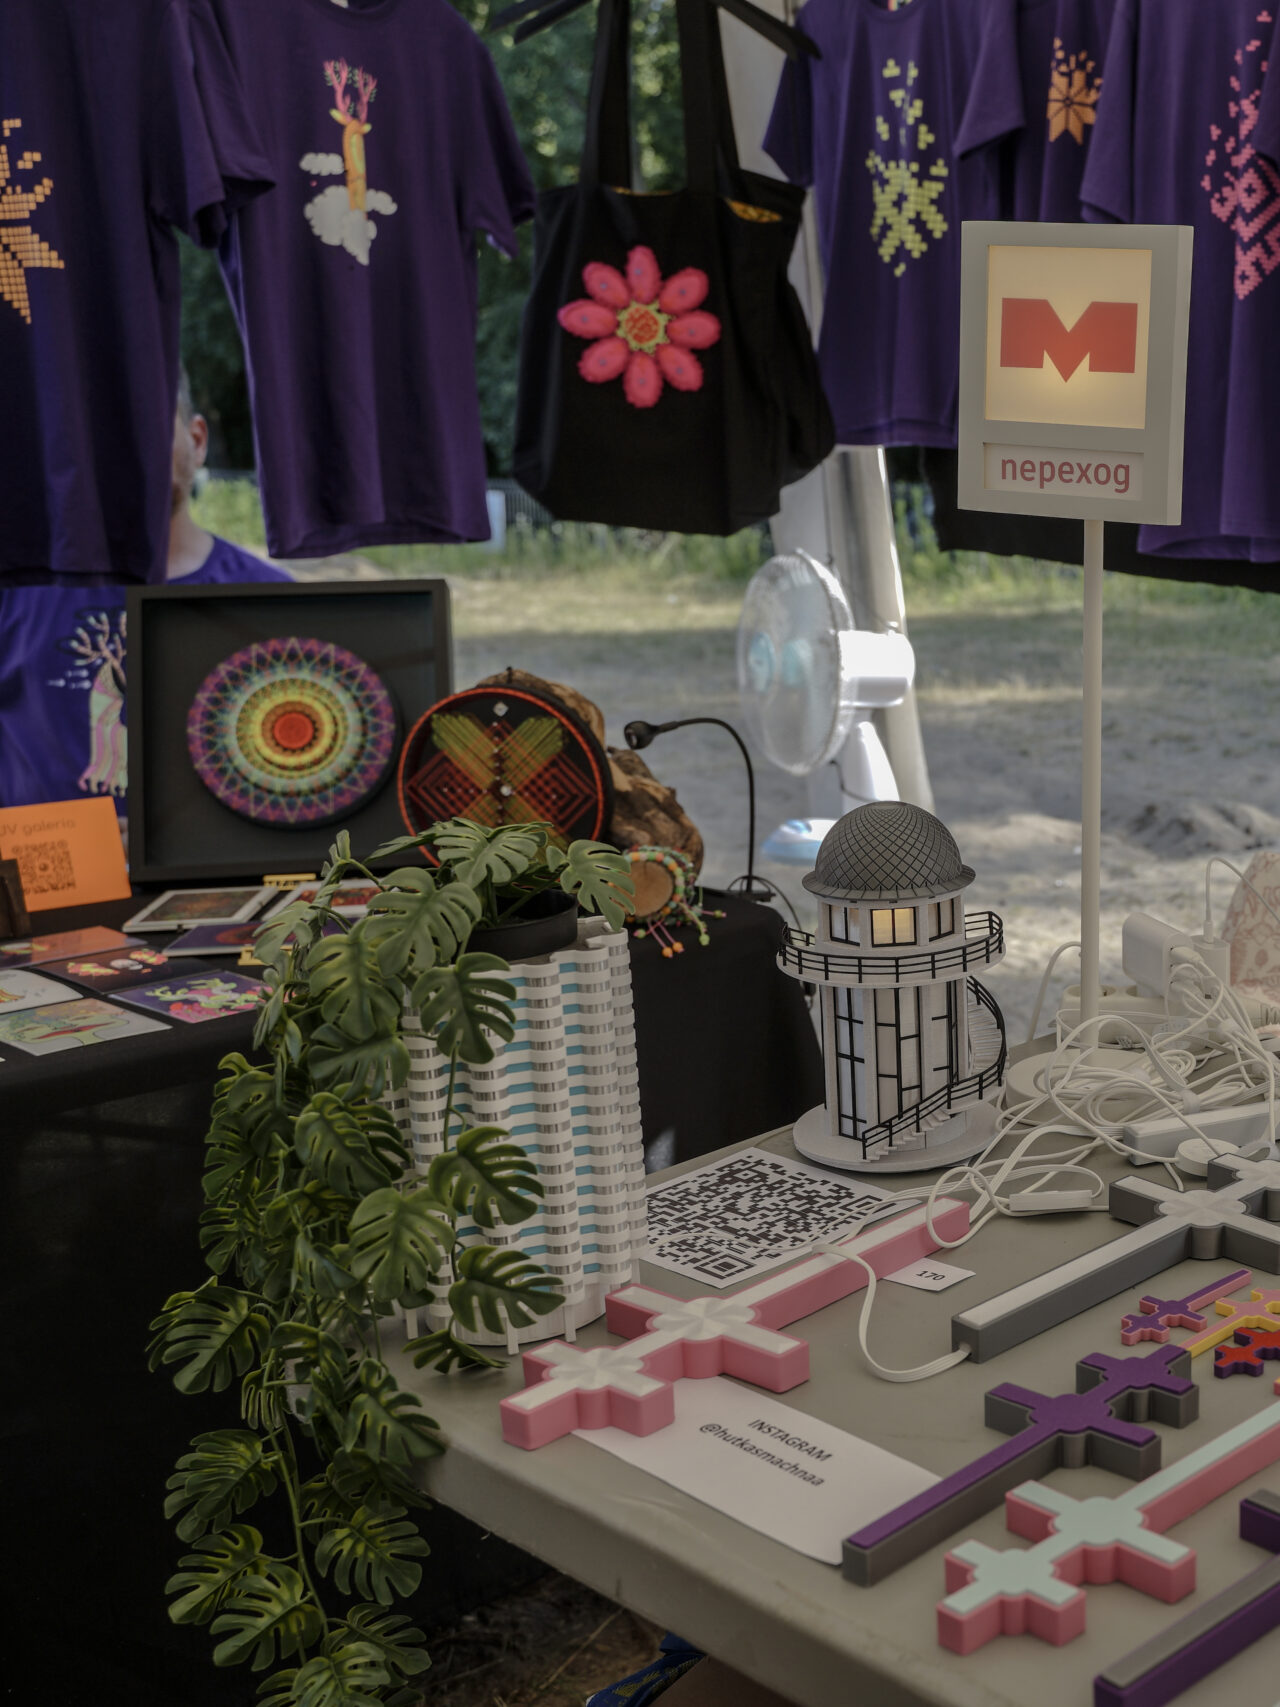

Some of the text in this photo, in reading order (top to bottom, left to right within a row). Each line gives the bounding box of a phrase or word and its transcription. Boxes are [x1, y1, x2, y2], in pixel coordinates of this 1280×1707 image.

[916, 1270, 946, 1281] 170
[699, 1422, 825, 1487] @hutkasmachnaa
[748, 1418, 833, 1462] INSTAGRAM
